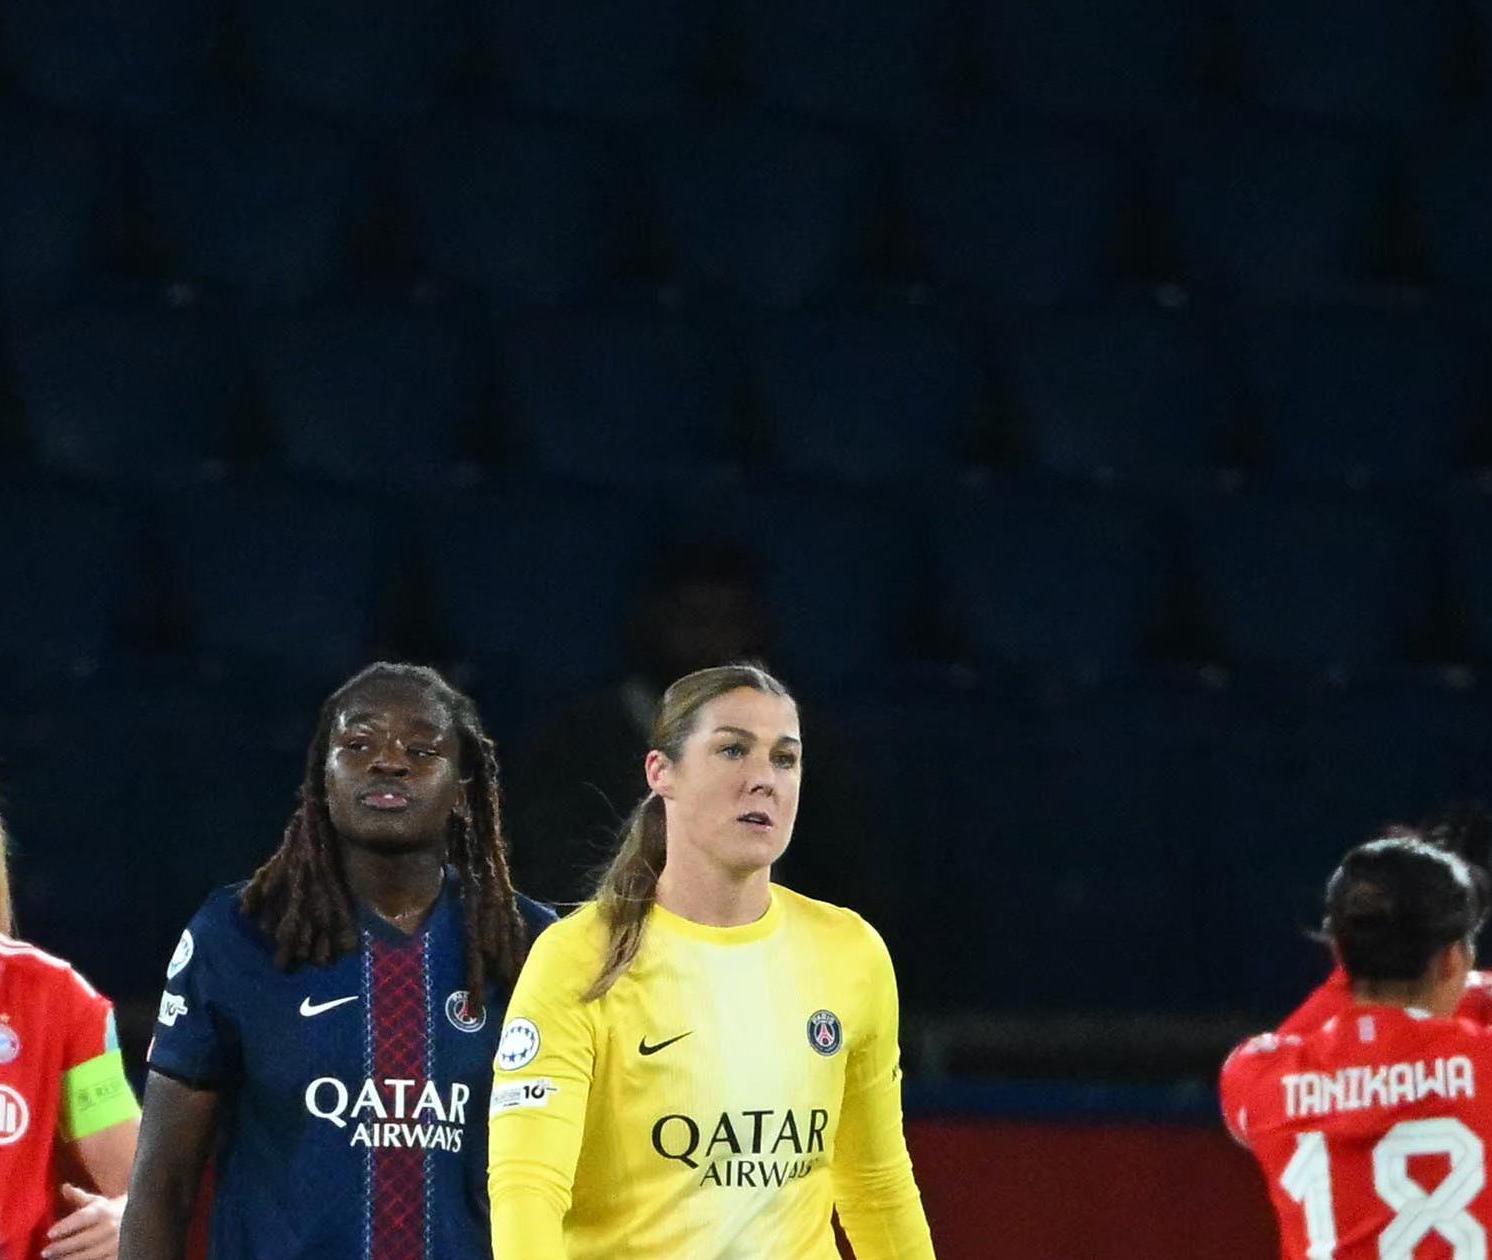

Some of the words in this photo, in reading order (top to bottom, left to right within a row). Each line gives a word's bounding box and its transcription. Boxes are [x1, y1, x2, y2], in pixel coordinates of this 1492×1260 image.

[304, 1076, 471, 1129] QATAR
[1281, 1055, 1476, 1119] TANIKAWA
[349, 1121, 464, 1154] AIRWAYS
[651, 1108, 829, 1170] QATAR
